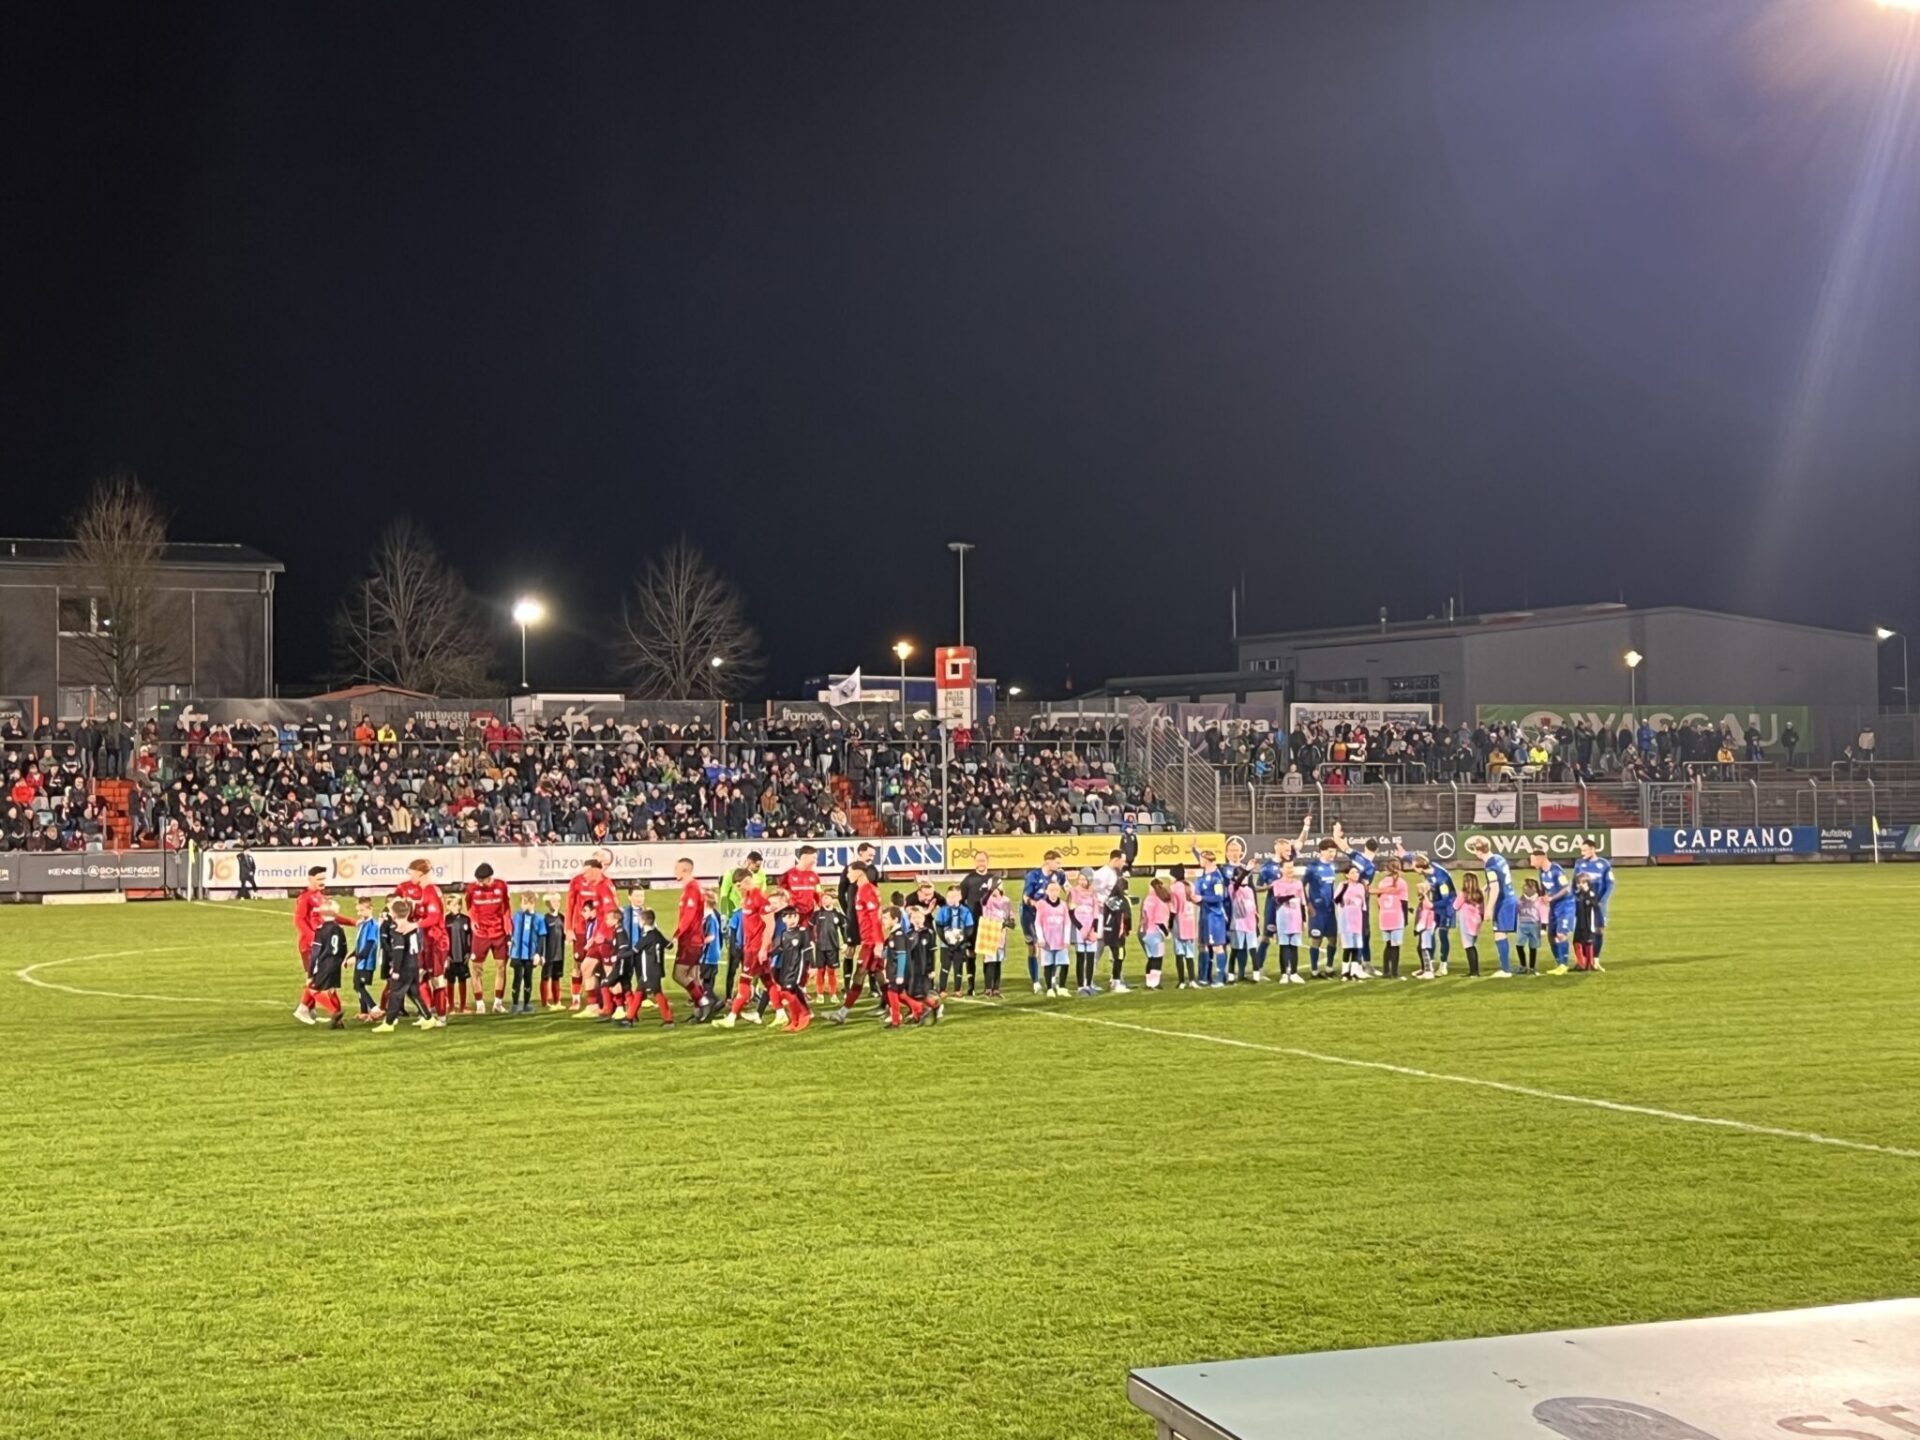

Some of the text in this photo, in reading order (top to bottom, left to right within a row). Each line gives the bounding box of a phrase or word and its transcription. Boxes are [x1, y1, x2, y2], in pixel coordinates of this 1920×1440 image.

[1491, 834, 1605, 854] WASGAU
[1673, 828, 1793, 848] CAPRANO
[615, 854, 653, 869] klein
[795, 845, 943, 867] EUANN
[257, 862, 308, 877] mmerli
[361, 863, 444, 881] Kömmeng
[311, 934, 320, 956] 9
